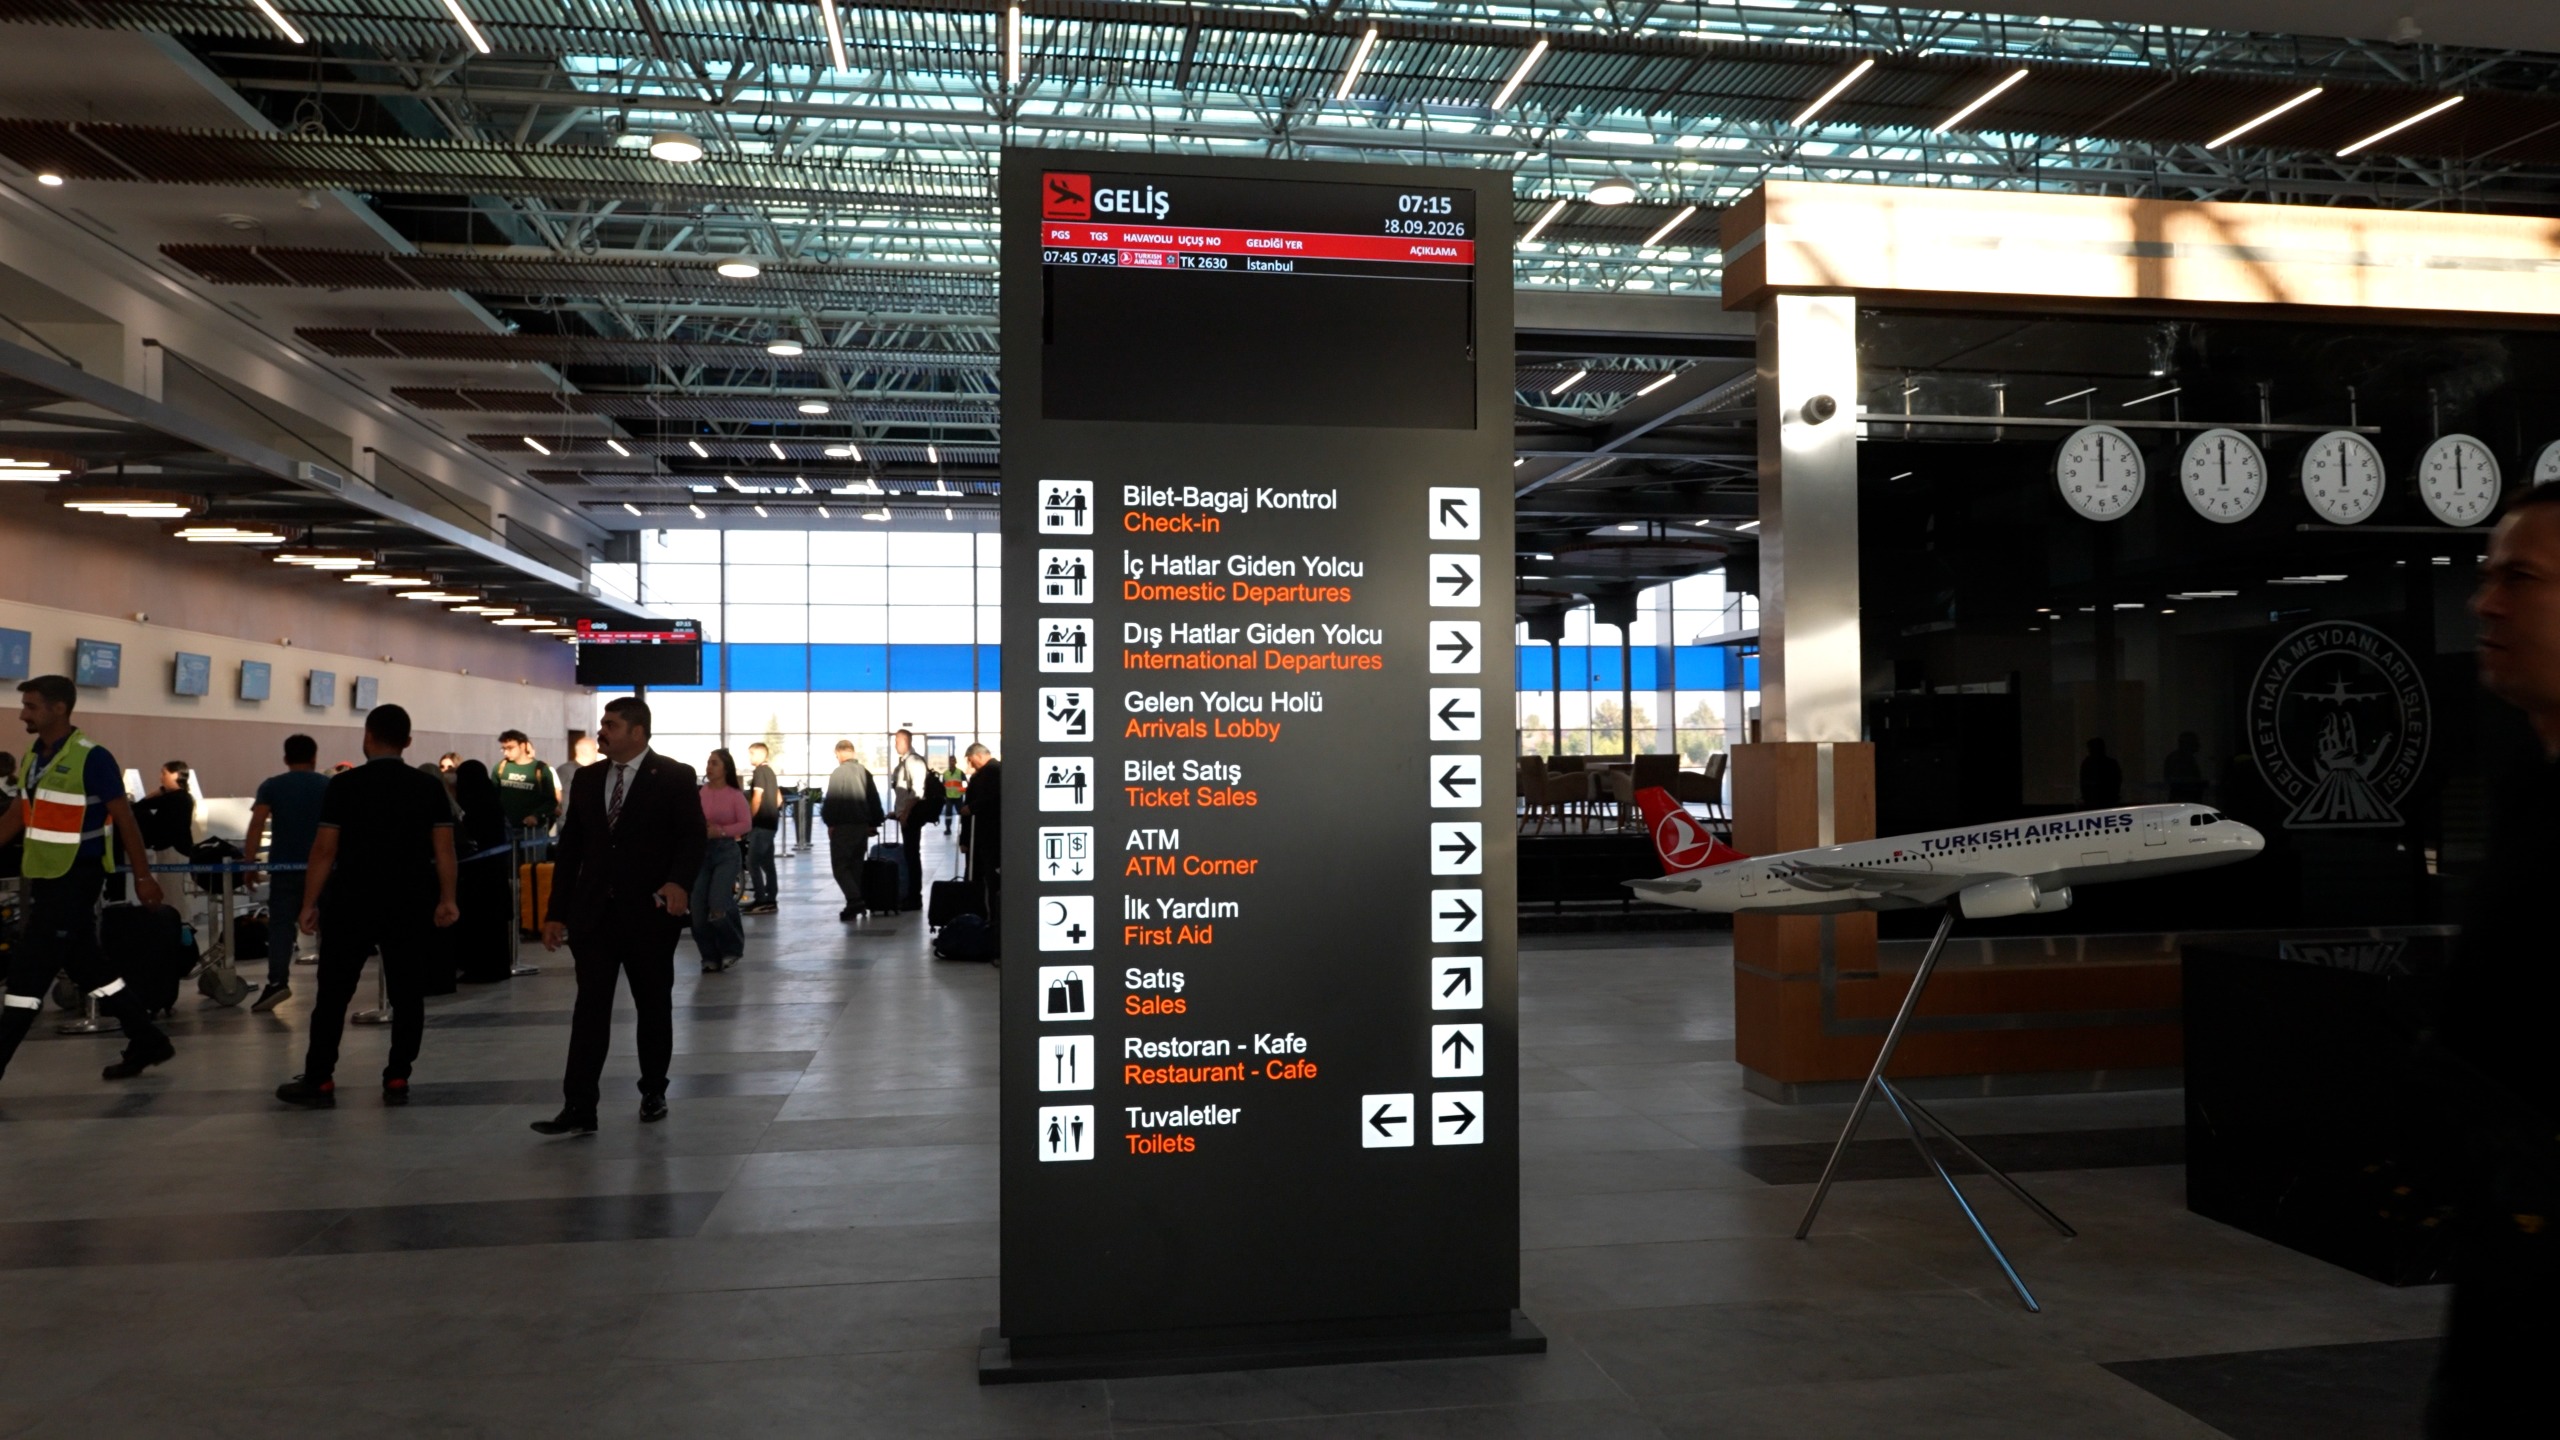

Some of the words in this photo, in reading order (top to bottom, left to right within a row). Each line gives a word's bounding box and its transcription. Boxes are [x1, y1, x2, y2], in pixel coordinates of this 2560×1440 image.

[1094, 185, 1170, 220] GELİŞ
[1398, 194, 1452, 214] 07:15
[1051, 230, 1070, 240] PGS
[1090, 231, 1108, 241] TGS
[1123, 233, 1173, 244] HAVAYOLU
[1178, 235, 1204, 247] UÇUŞ
[1206, 236, 1221, 246] NO
[1285, 239, 1303, 250] YER
[1043, 250, 1078, 263] 07:45
[1082, 252, 1116, 265] 07:45
[1133, 258, 1163, 266] AIRLINES
[1410, 245, 1457, 258] AÇIKLAMA
[1180, 256, 1195, 268] TK
[1198, 257, 1228, 269] 2630
[1247, 256, 1294, 272] İstanbul
[1124, 485, 1248, 513] Bilet-Bagaj
[1257, 488, 1336, 509] Kontrol
[1124, 512, 1220, 532] Check-in
[1124, 550, 1143, 579] İç
[1152, 554, 1221, 575] Hatlar
[1227, 555, 1295, 576] Giden
[1302, 556, 1363, 577] Yolcu
[1124, 580, 1226, 601] Domestic
[1232, 582, 1352, 606] Departures
[1124, 623, 1162, 648] Dış
[1171, 623, 1240, 644] Hatlar
[1247, 623, 1315, 644] Giden
[1321, 624, 1382, 645] Yolcu
[1124, 650, 1258, 670] International
[1264, 649, 1383, 674] Departures
[2290, 628, 2411, 683] MEYDANLARI
[2258, 658, 2292, 711] HAVA
[1125, 691, 1193, 712] Gelen
[1200, 691, 1262, 712] Yolcu
[1271, 691, 1323, 712] Holü
[1125, 718, 1208, 738] Arrivals
[1214, 718, 1280, 742] Lobby
[2258, 718, 2303, 797] DEVLET
[1125, 760, 1175, 781] Bilet
[1183, 760, 1241, 785] Satış
[1125, 787, 1190, 807] Ticket
[1197, 786, 1258, 806] Sales
[1126, 829, 1179, 850] ATM
[1922, 828, 2019, 852] TURKISH
[2025, 814, 2133, 839] AIRLINES
[1126, 856, 1175, 876] ATM
[1183, 855, 1258, 875] Corner
[1125, 895, 1150, 919] İlk
[1156, 897, 1238, 919] Yardım
[1125, 926, 1172, 945] First
[1177, 925, 1212, 944] Aid
[1125, 968, 1184, 993] Satış
[1125, 995, 1186, 1015] Sales
[1125, 1037, 1230, 1058] Restoran
[1255, 1033, 1307, 1054] Kafe
[1125, 1063, 1244, 1084] Restaurant
[1266, 1059, 1317, 1079] Cafe
[1125, 1104, 1241, 1128] Tuvaletler
[1126, 1134, 1195, 1154] Toilets
